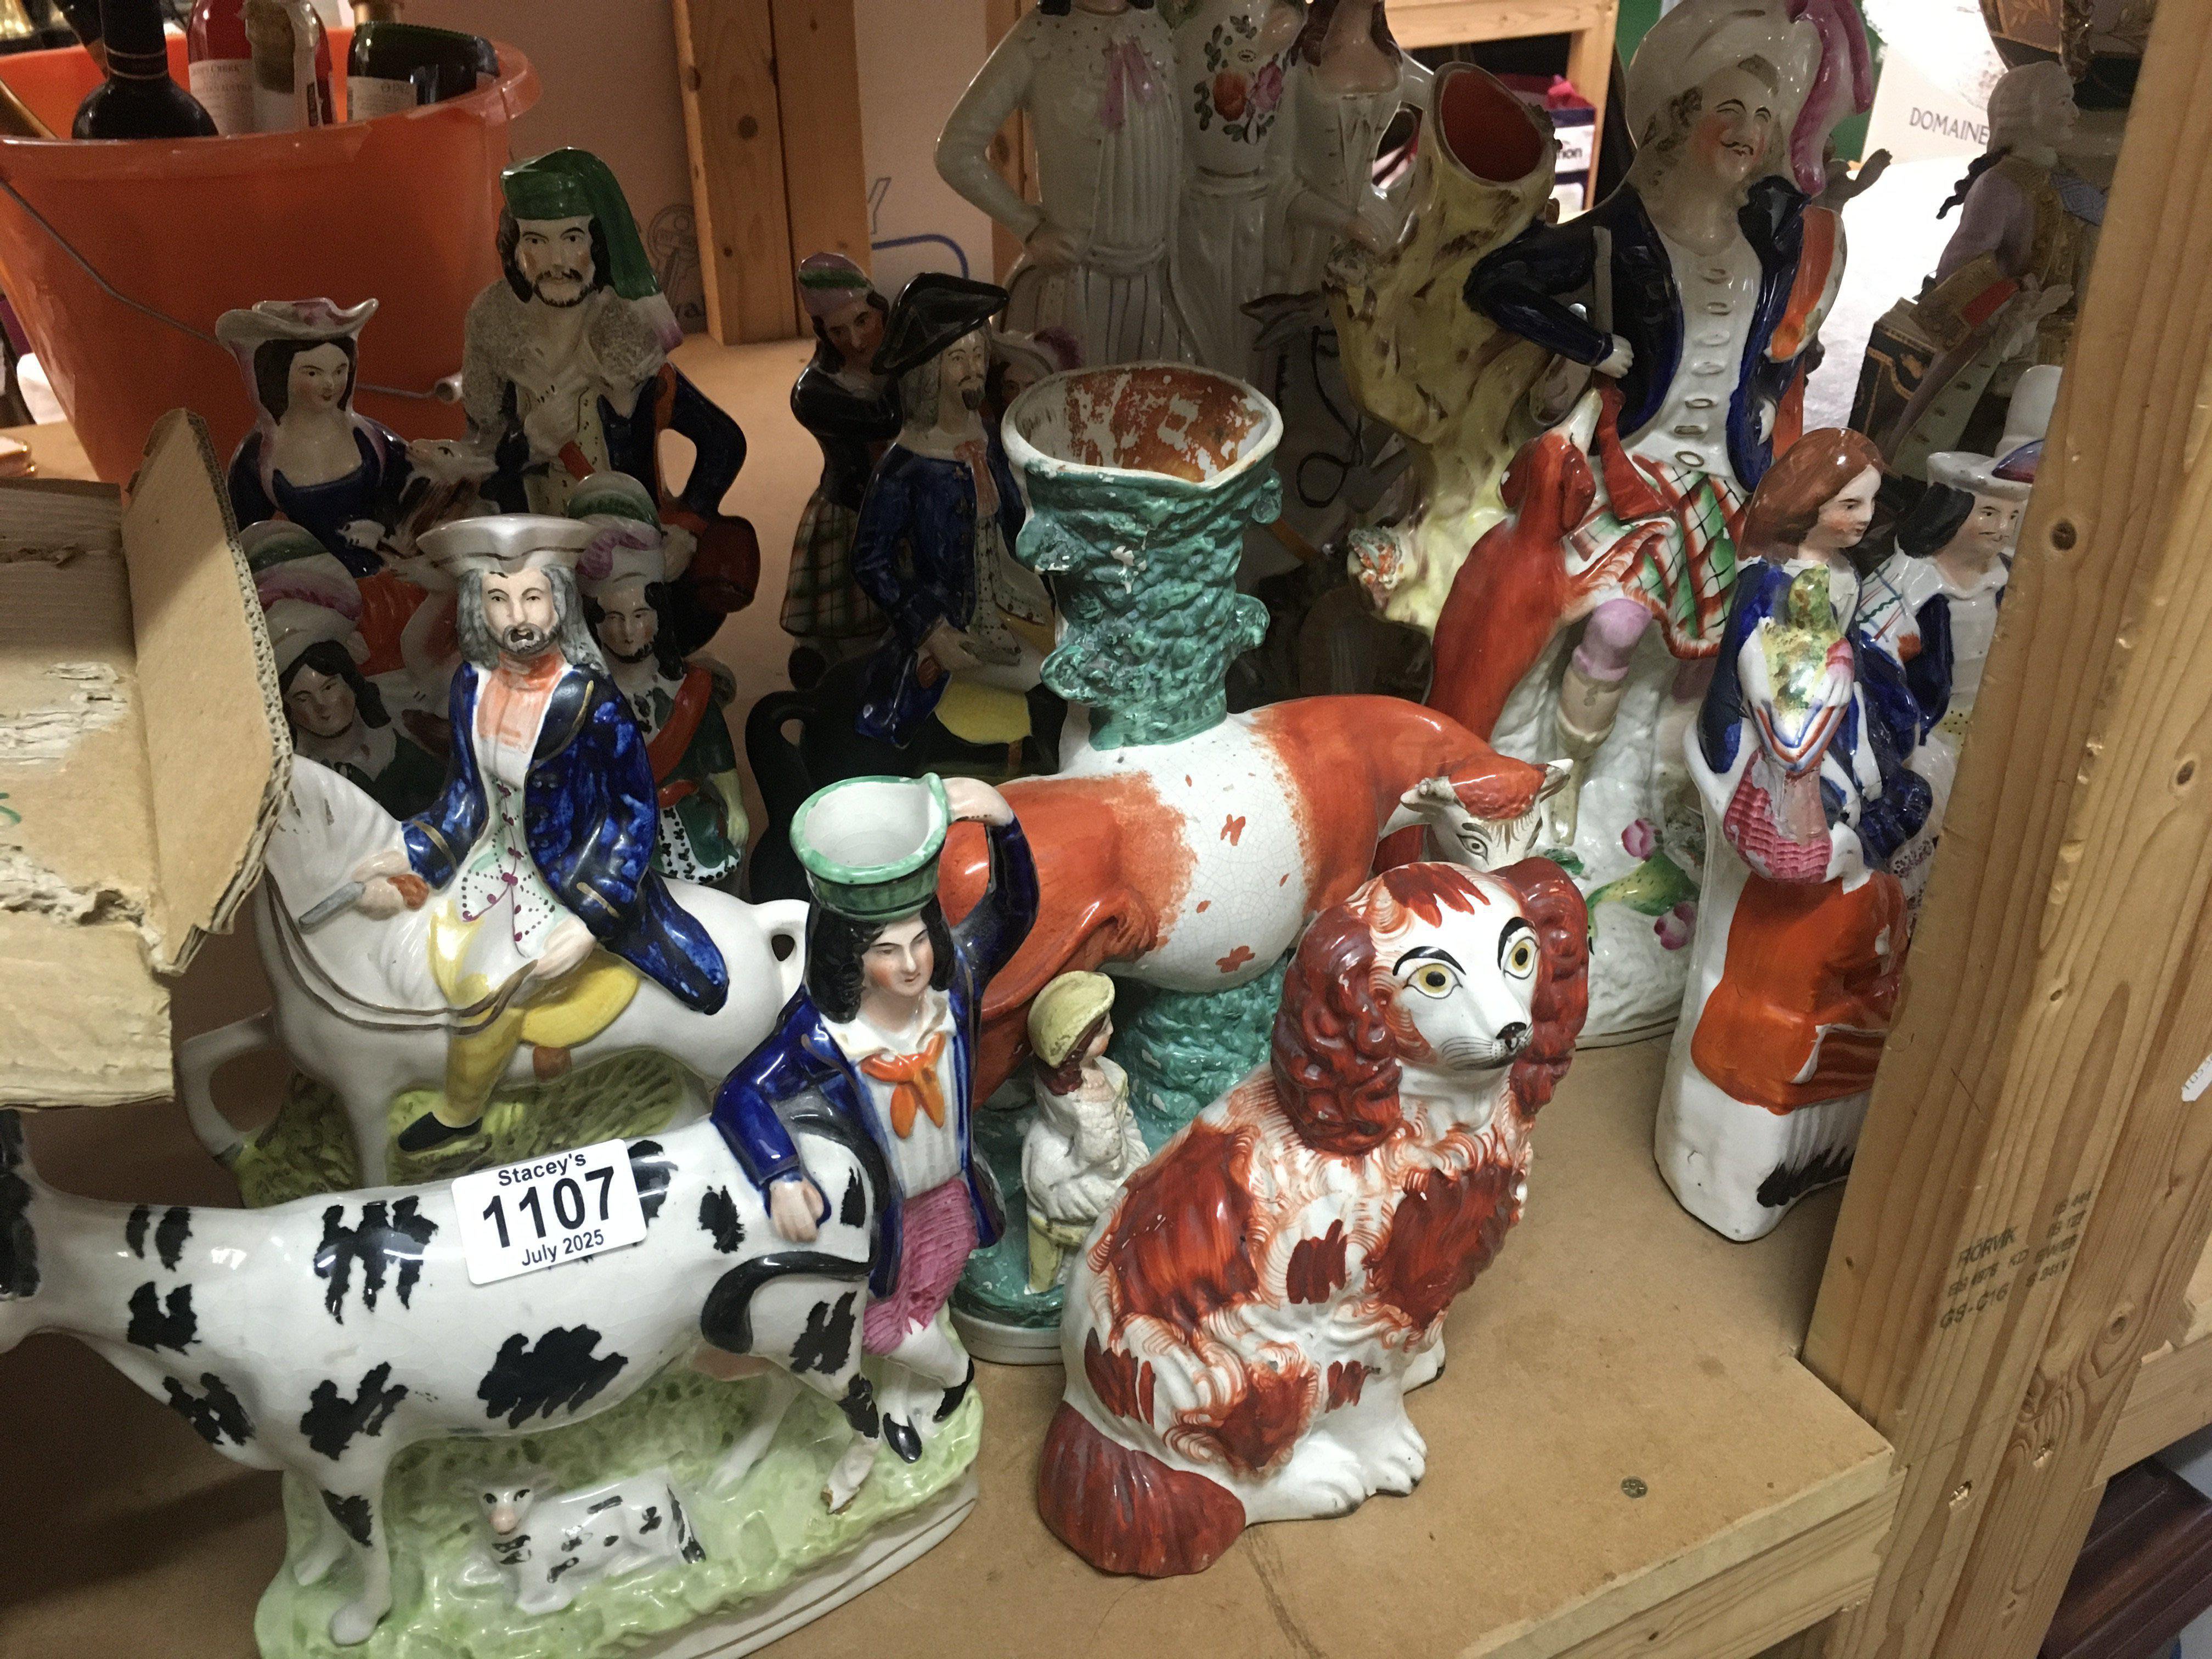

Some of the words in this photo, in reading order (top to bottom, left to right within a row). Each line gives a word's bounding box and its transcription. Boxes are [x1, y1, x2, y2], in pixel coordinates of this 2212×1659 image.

[1909, 107, 1990, 145] DOMAINE
[498, 1153, 586, 1186] Stacey's
[483, 1166, 614, 1248] 1107
[522, 1245, 557, 1266] July
[562, 1229, 604, 1255] 2025
